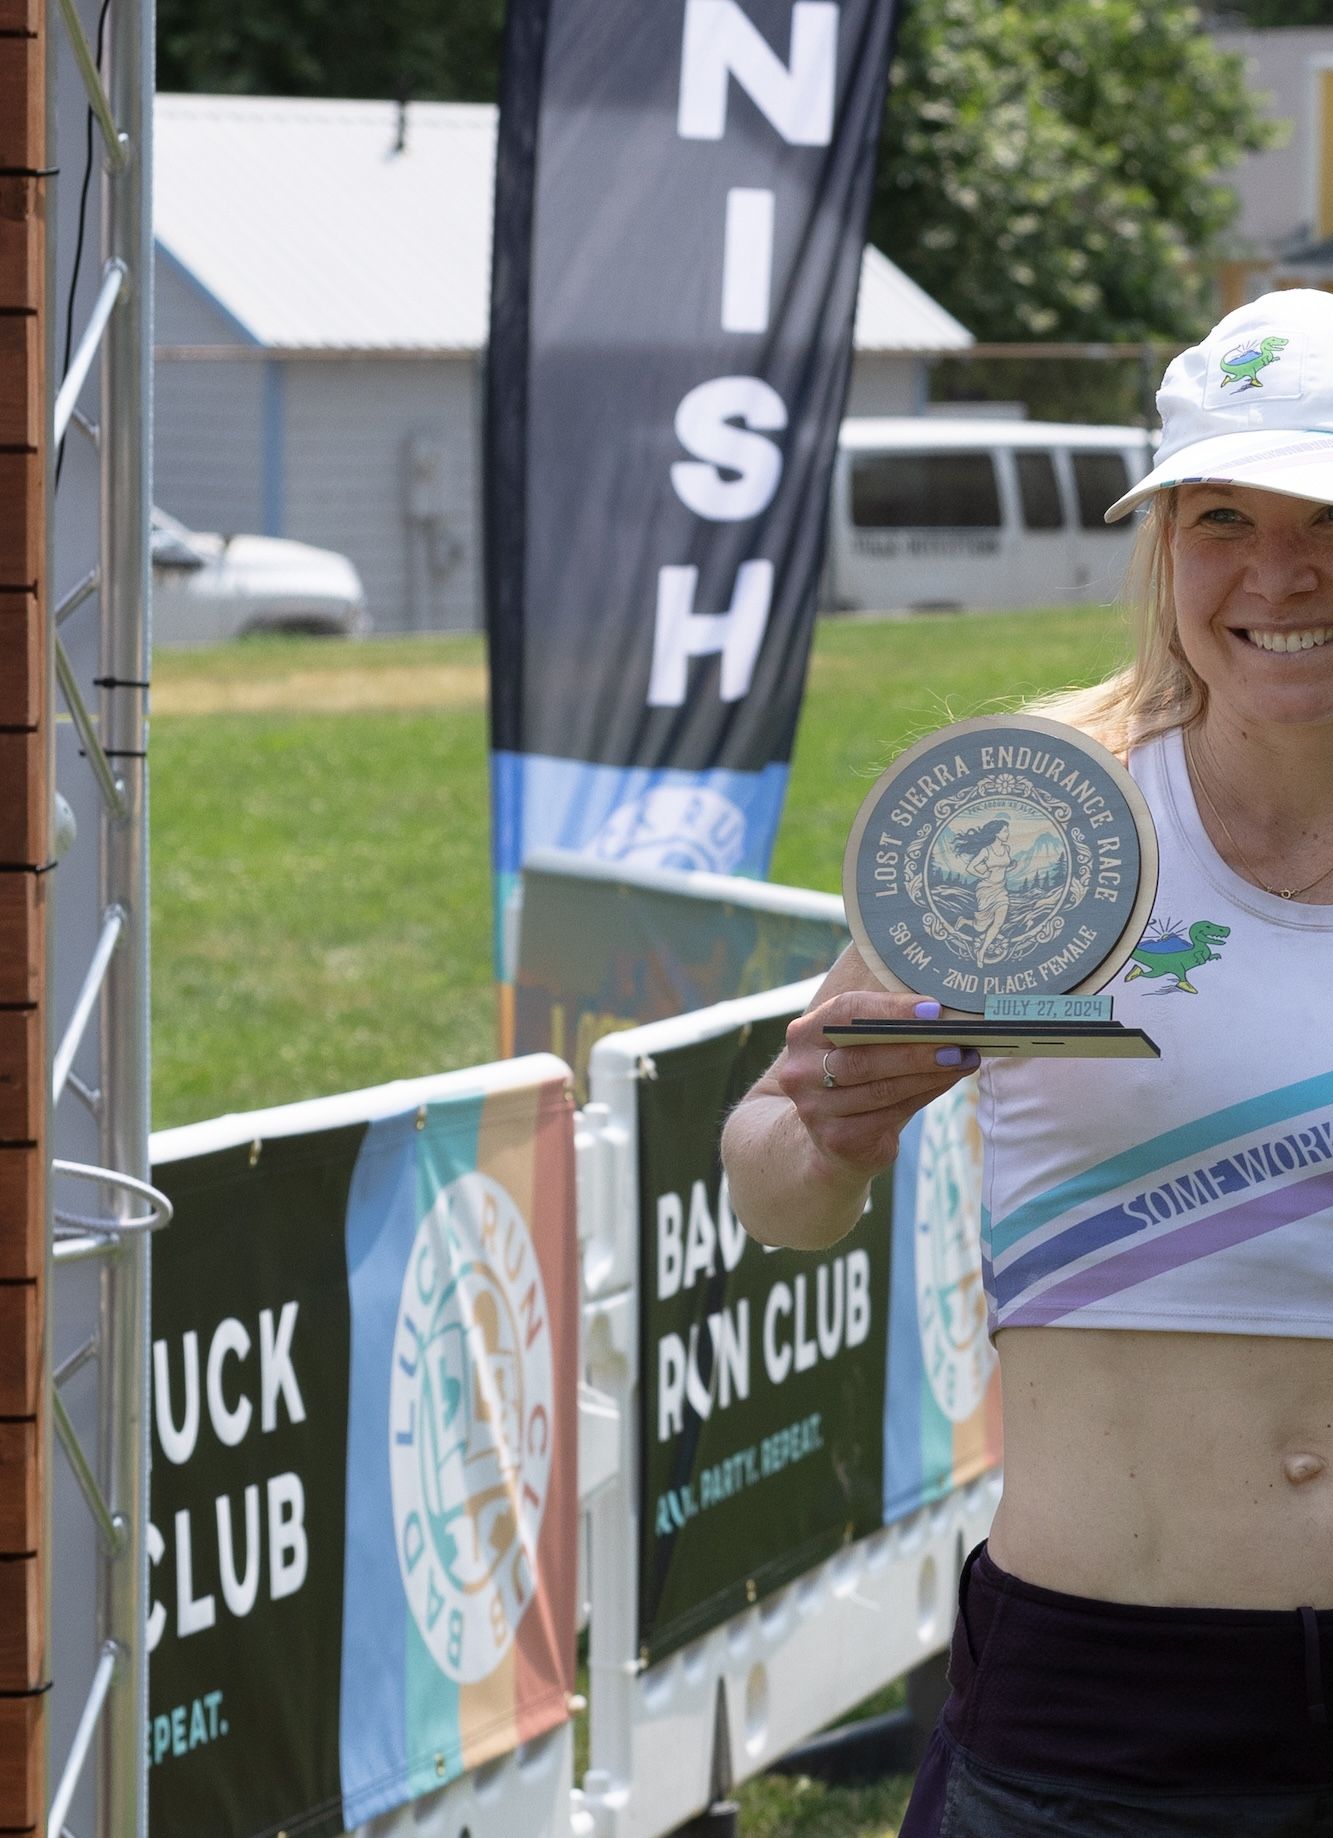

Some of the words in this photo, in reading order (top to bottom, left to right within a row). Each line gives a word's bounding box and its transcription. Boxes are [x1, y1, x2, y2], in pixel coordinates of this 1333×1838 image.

[875, 831, 902, 898] LOST
[890, 755, 970, 827] SIERRA
[981, 746, 1113, 830] ENDURANCE
[1094, 835, 1122, 903] RACE
[903, 942, 932, 971] KM
[942, 968, 978, 993] 2ND
[983, 970, 1038, 994] PLACE
[1038, 925, 1098, 981] FEMALE
[992, 1000, 1030, 1016] JULY
[1037, 1000, 1057, 1017] 27,
[1064, 1000, 1102, 1017] 2024
[1123, 1161, 1229, 1226] SOME
[481, 1194, 542, 1351] RUN
[763, 1249, 870, 1385] CLUB
[150, 1300, 306, 1466] UCK
[700, 1445, 760, 1510] PARTY.
[761, 1412, 825, 1477] REPEAT.
[147, 1690, 230, 1769] PEAT.
